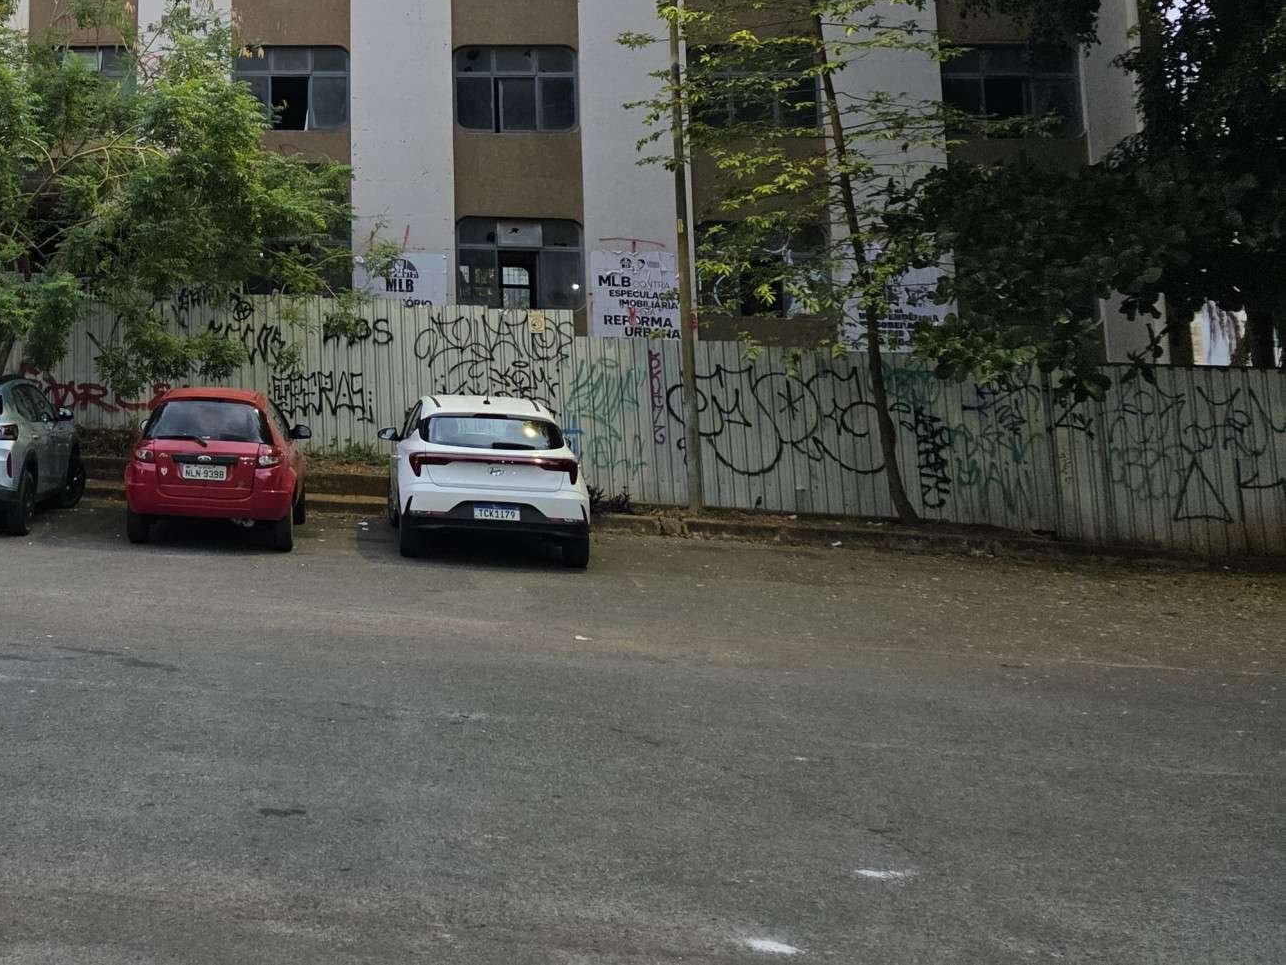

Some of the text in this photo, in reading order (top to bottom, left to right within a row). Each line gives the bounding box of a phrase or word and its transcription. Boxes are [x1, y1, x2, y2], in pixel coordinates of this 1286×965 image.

[386, 279, 414, 292] MLB
[598, 275, 631, 287] MLB
[604, 315, 673, 328] REFORMA
